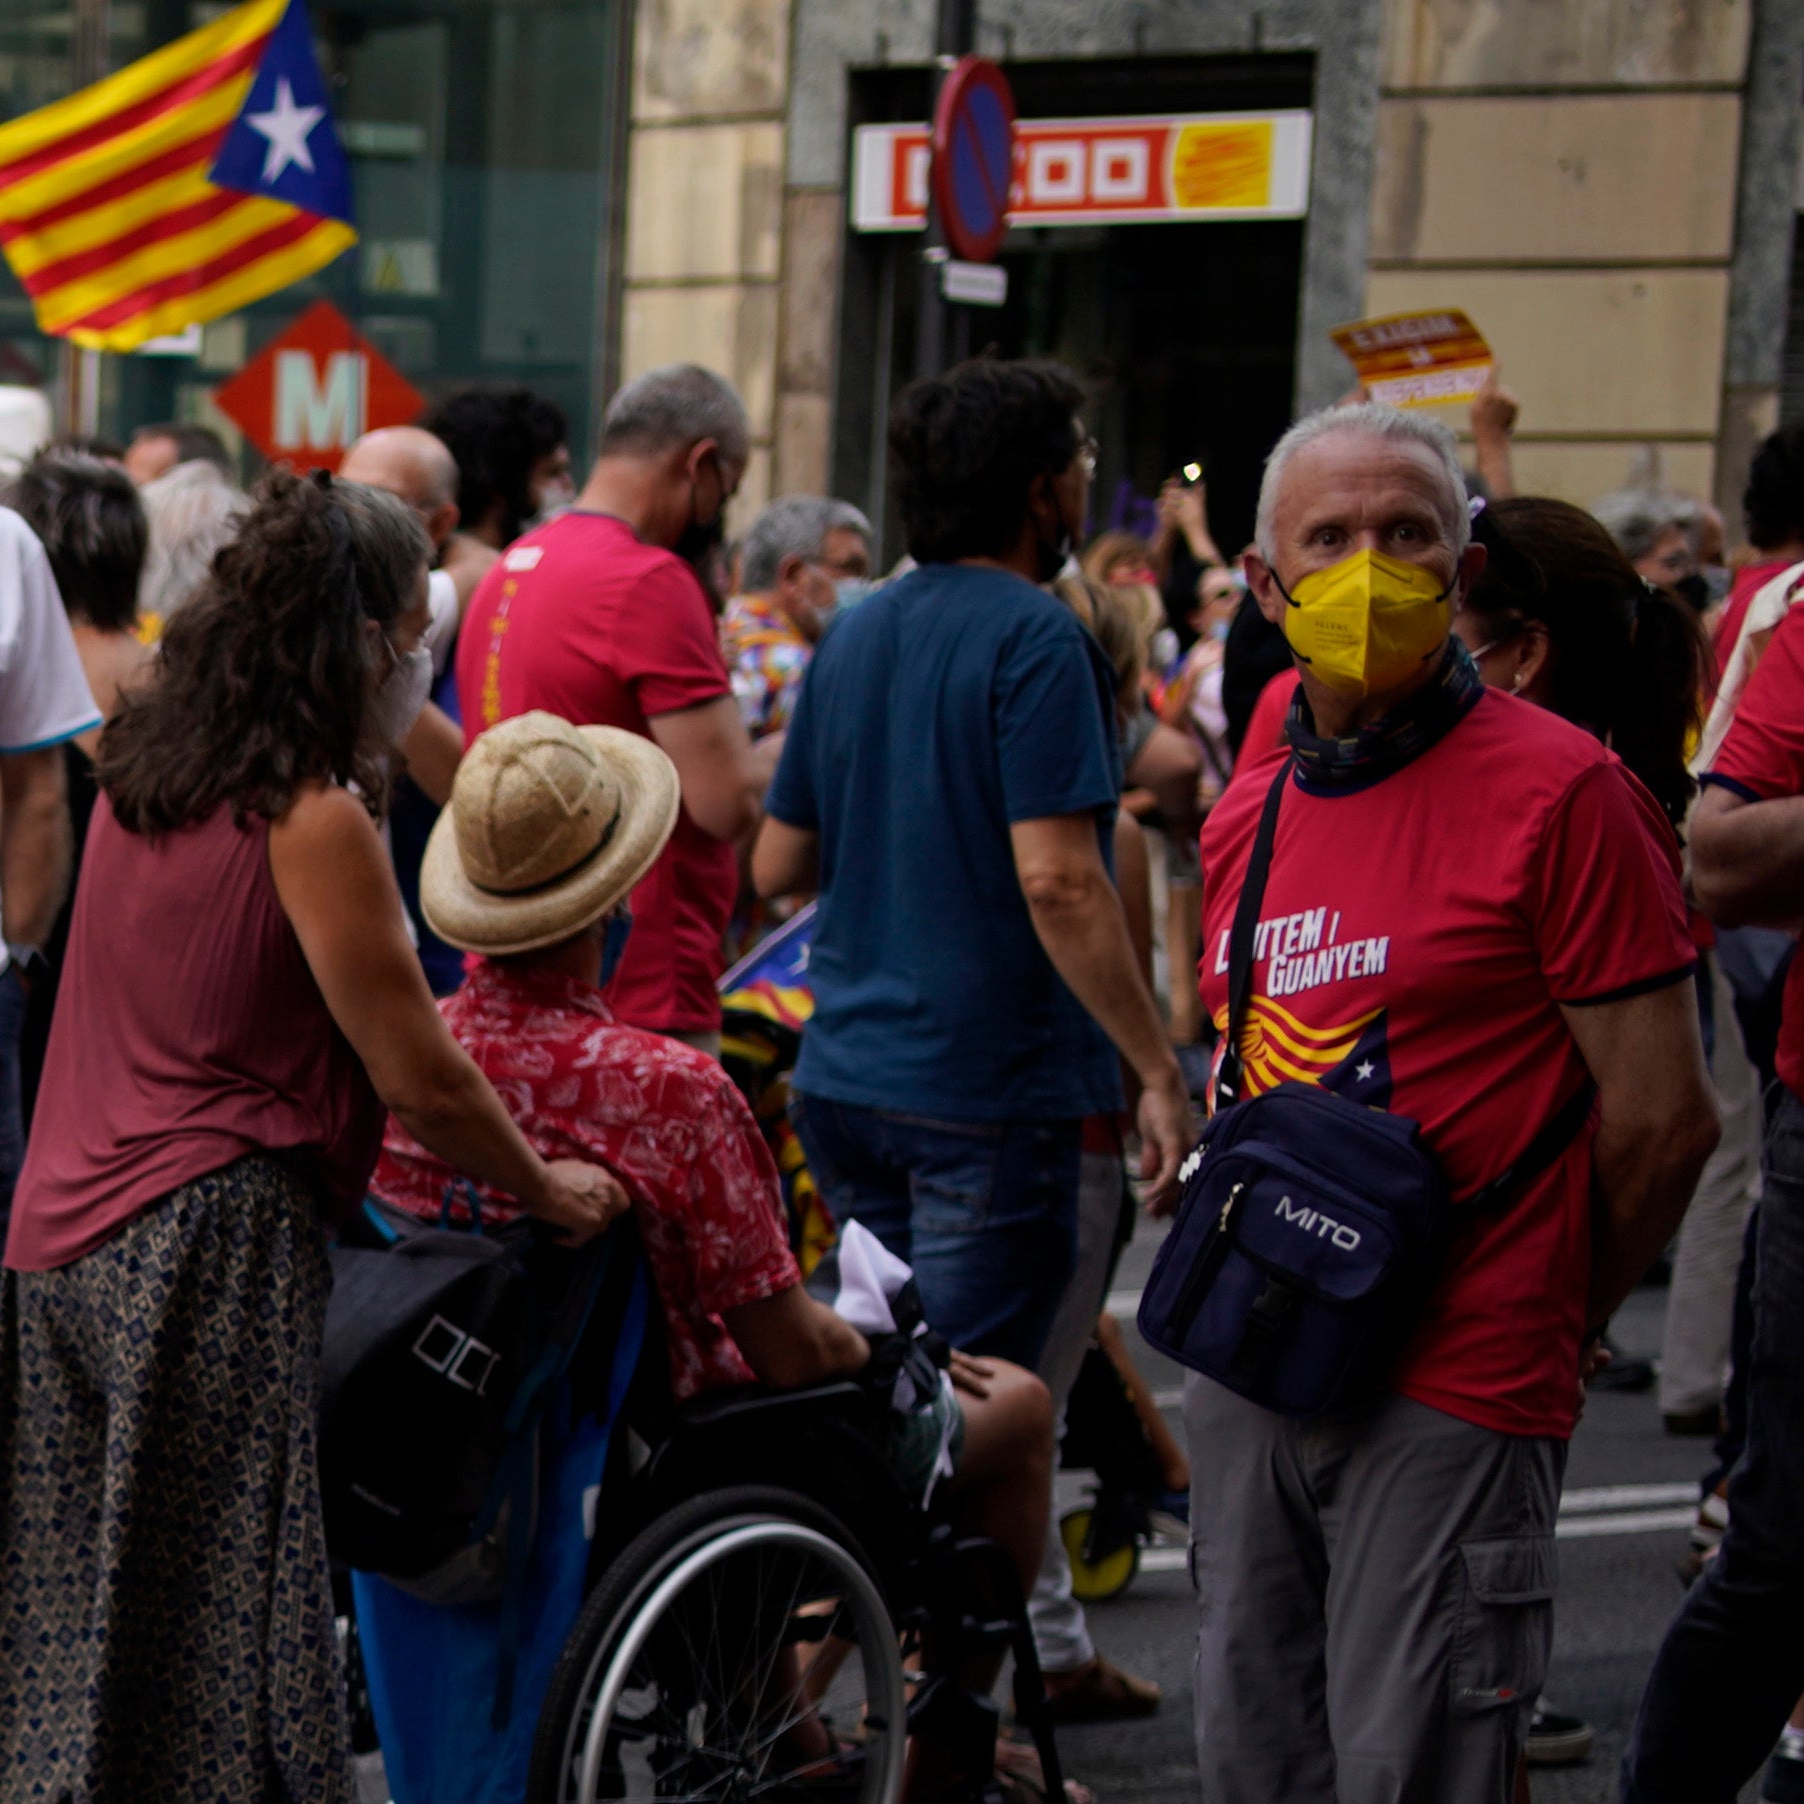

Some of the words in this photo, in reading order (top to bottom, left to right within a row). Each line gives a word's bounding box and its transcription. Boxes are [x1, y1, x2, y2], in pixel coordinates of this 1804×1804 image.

[906, 137, 1149, 212] OO
[273, 351, 367, 450] M
[1214, 906, 1327, 976] LITEM
[1266, 936, 1391, 998] GUANYEM
[1274, 1194, 1362, 1253] MITO
